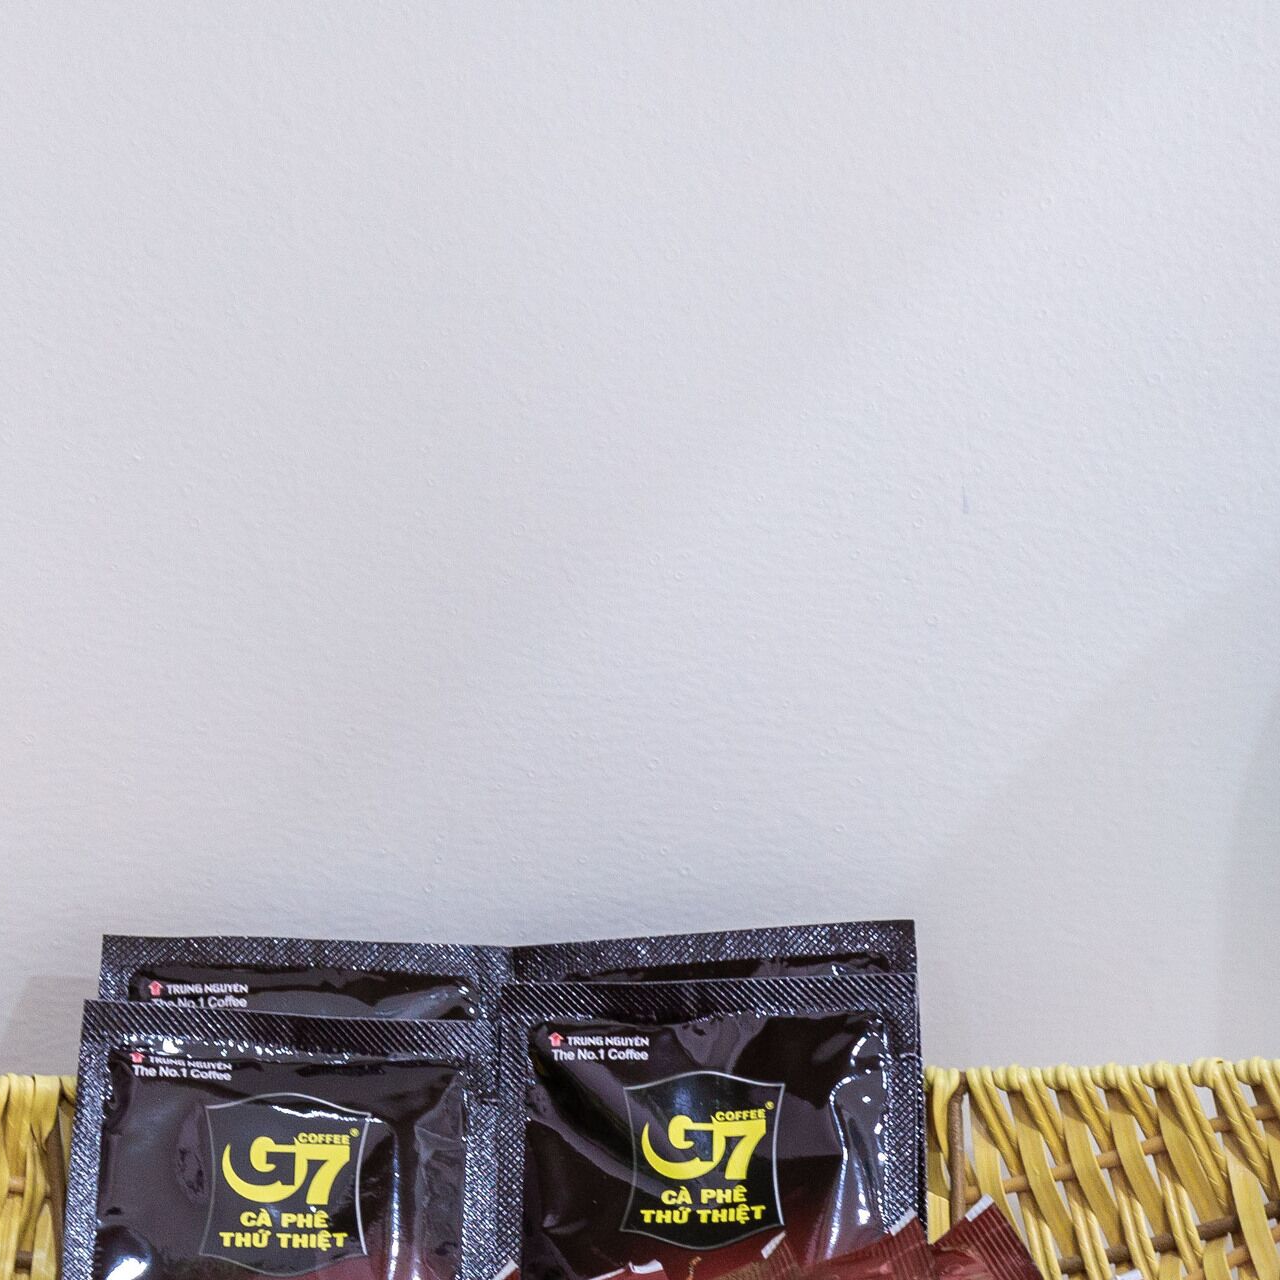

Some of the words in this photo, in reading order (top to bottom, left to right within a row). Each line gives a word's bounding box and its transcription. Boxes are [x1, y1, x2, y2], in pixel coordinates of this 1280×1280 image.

[166, 983, 202, 995] TRUNG
[207, 995, 248, 1008] Coffee
[566, 1035, 603, 1046] TRUNG
[149, 1055, 185, 1067] TRUNG
[551, 1048, 575, 1061] The
[577, 1047, 605, 1060] No.1
[607, 1047, 649, 1060] Coffee
[132, 1064, 157, 1078] The
[159, 1065, 188, 1078] No.1
[190, 1068, 232, 1081] Coffee
[715, 1108, 766, 1122] COFFEE
[297, 1132, 350, 1145] COFFEE
[641, 1114, 767, 1181] G7
[222, 1136, 350, 1205] G7
[661, 1185, 692, 1205] CÀ
[700, 1184, 747, 1204] PHÊ
[239, 1208, 272, 1228] CÀ
[281, 1210, 329, 1228] PHÊ
[696, 1203, 766, 1224] THIỆT
[276, 1230, 348, 1251] THIỆT
